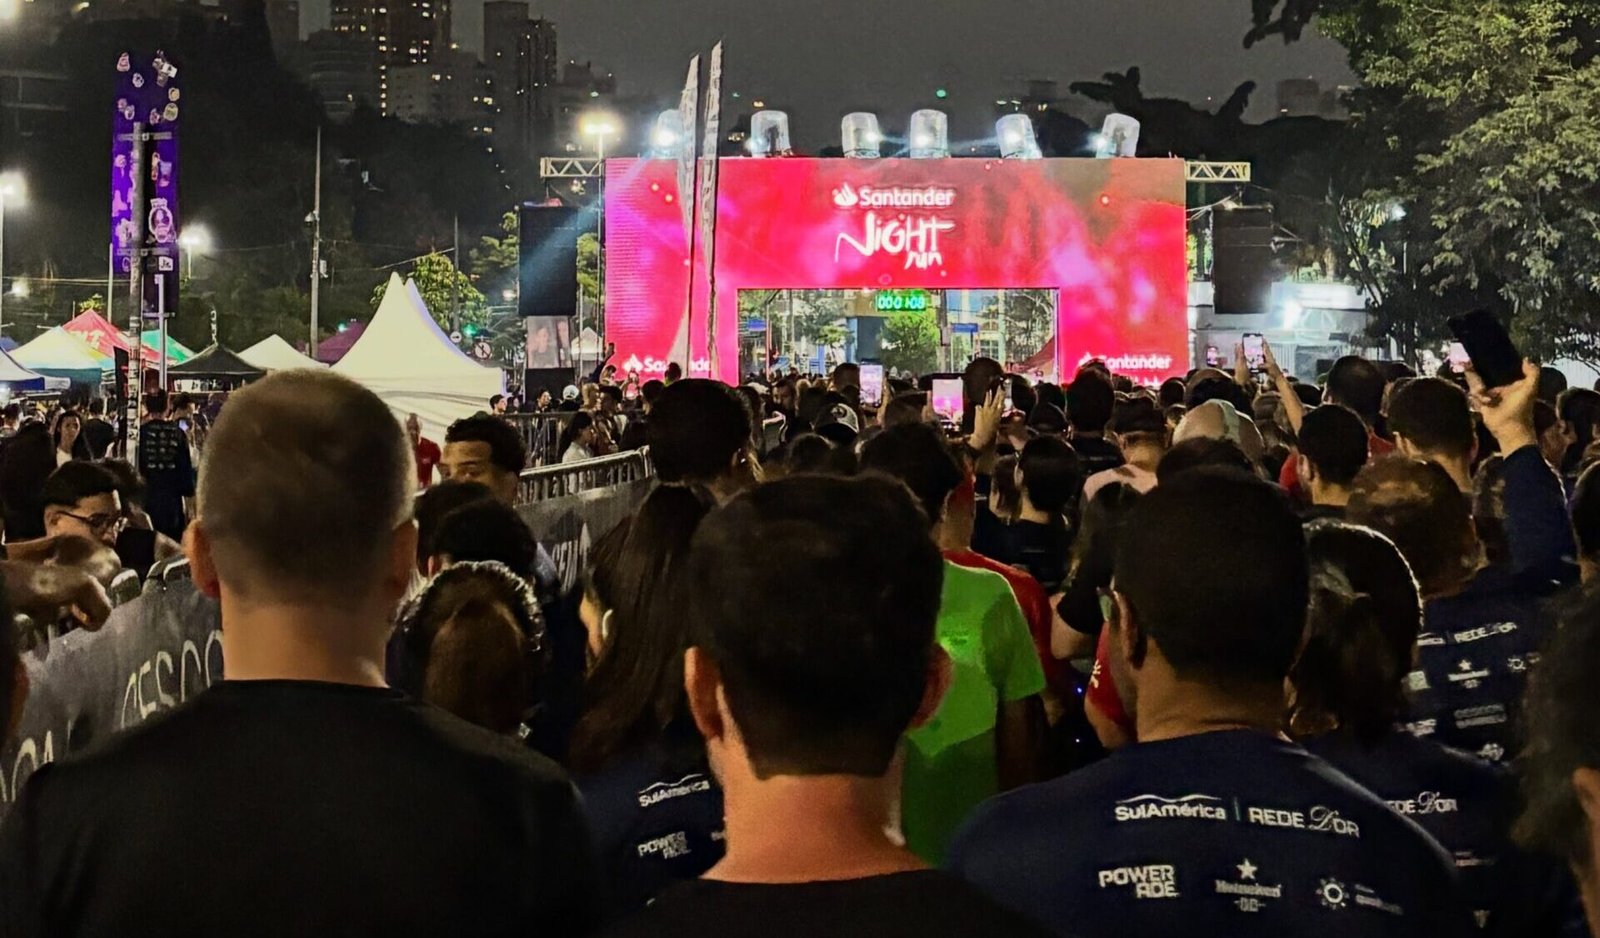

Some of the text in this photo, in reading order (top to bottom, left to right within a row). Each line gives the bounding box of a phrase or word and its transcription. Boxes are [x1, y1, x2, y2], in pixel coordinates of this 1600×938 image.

[859, 186, 956, 207] Santander
[1115, 803, 1226, 821] SulAmérica
[1248, 807, 1305, 829] REDE
